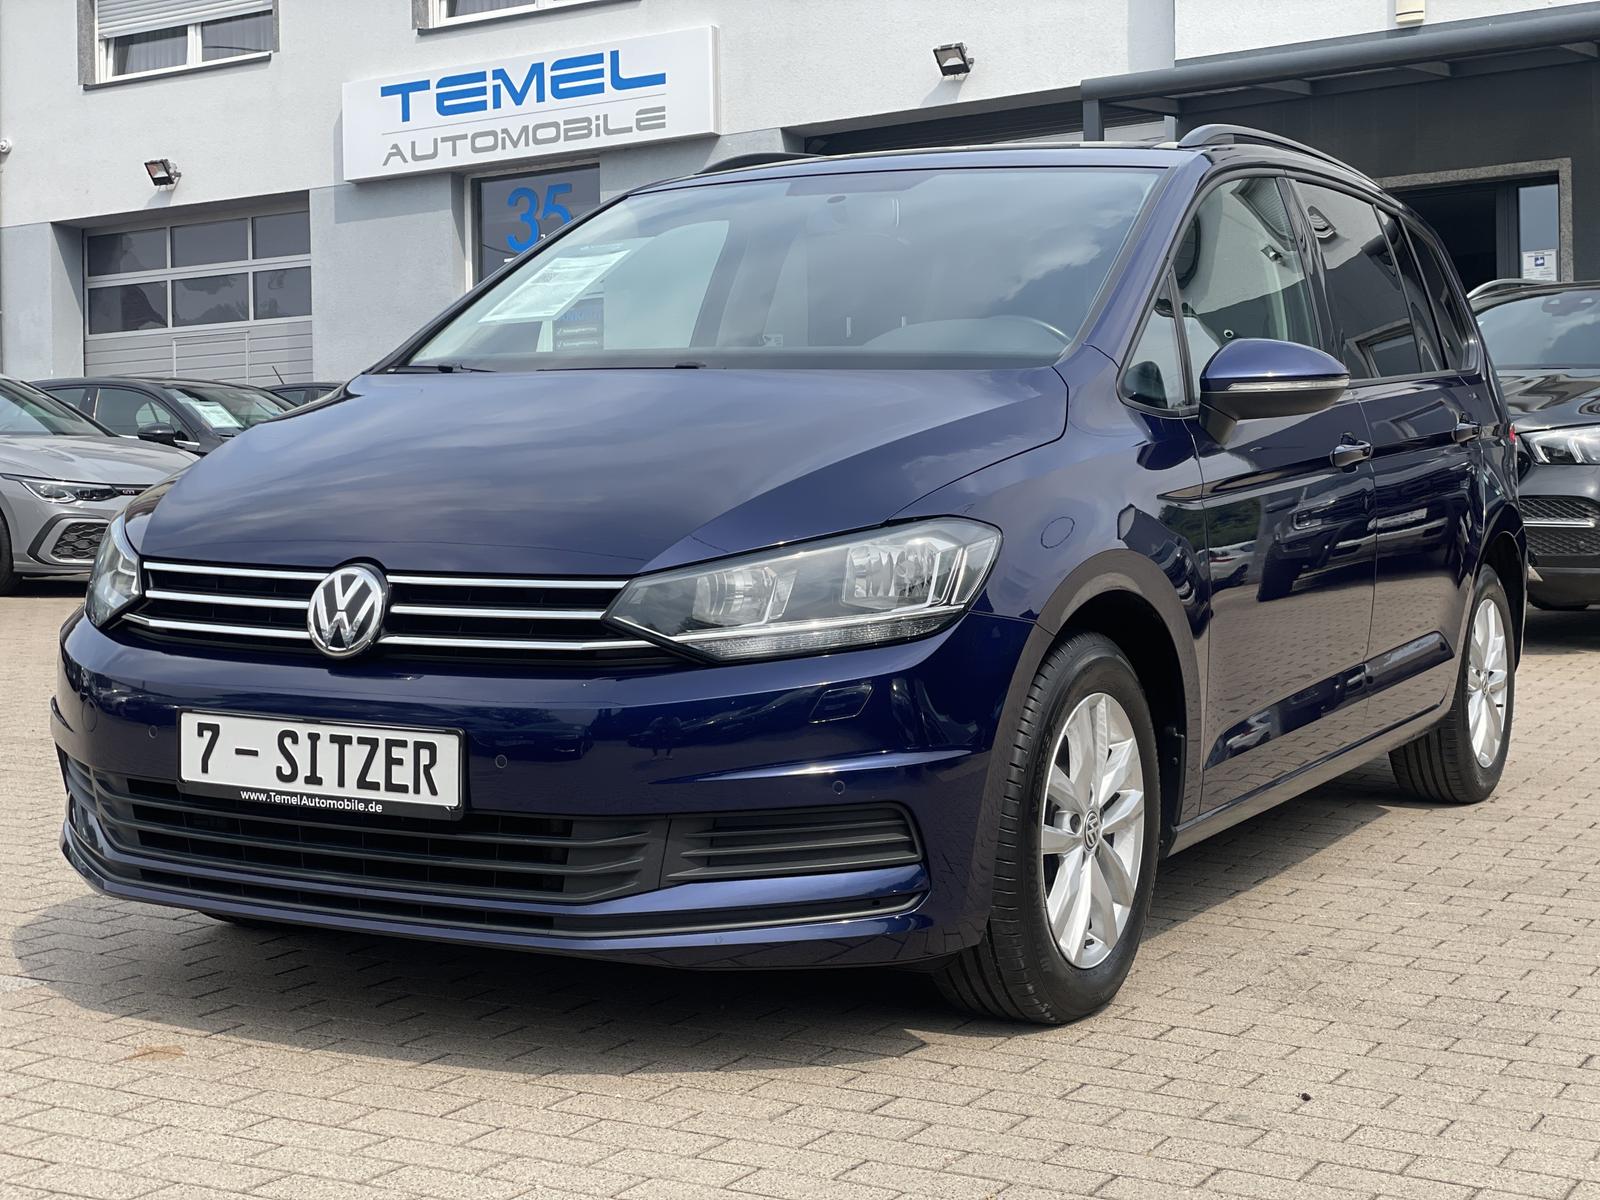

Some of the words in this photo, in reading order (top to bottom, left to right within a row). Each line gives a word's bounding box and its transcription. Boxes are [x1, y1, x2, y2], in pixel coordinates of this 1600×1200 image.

[380, 50, 667, 123] TEMEL
[506, 182, 573, 254] 35
[197, 722, 220, 774] 7
[234, 747, 259, 757] -
[276, 729, 439, 796] SITZER
[240, 790, 383, 813] www.TemelAutomobile.de
